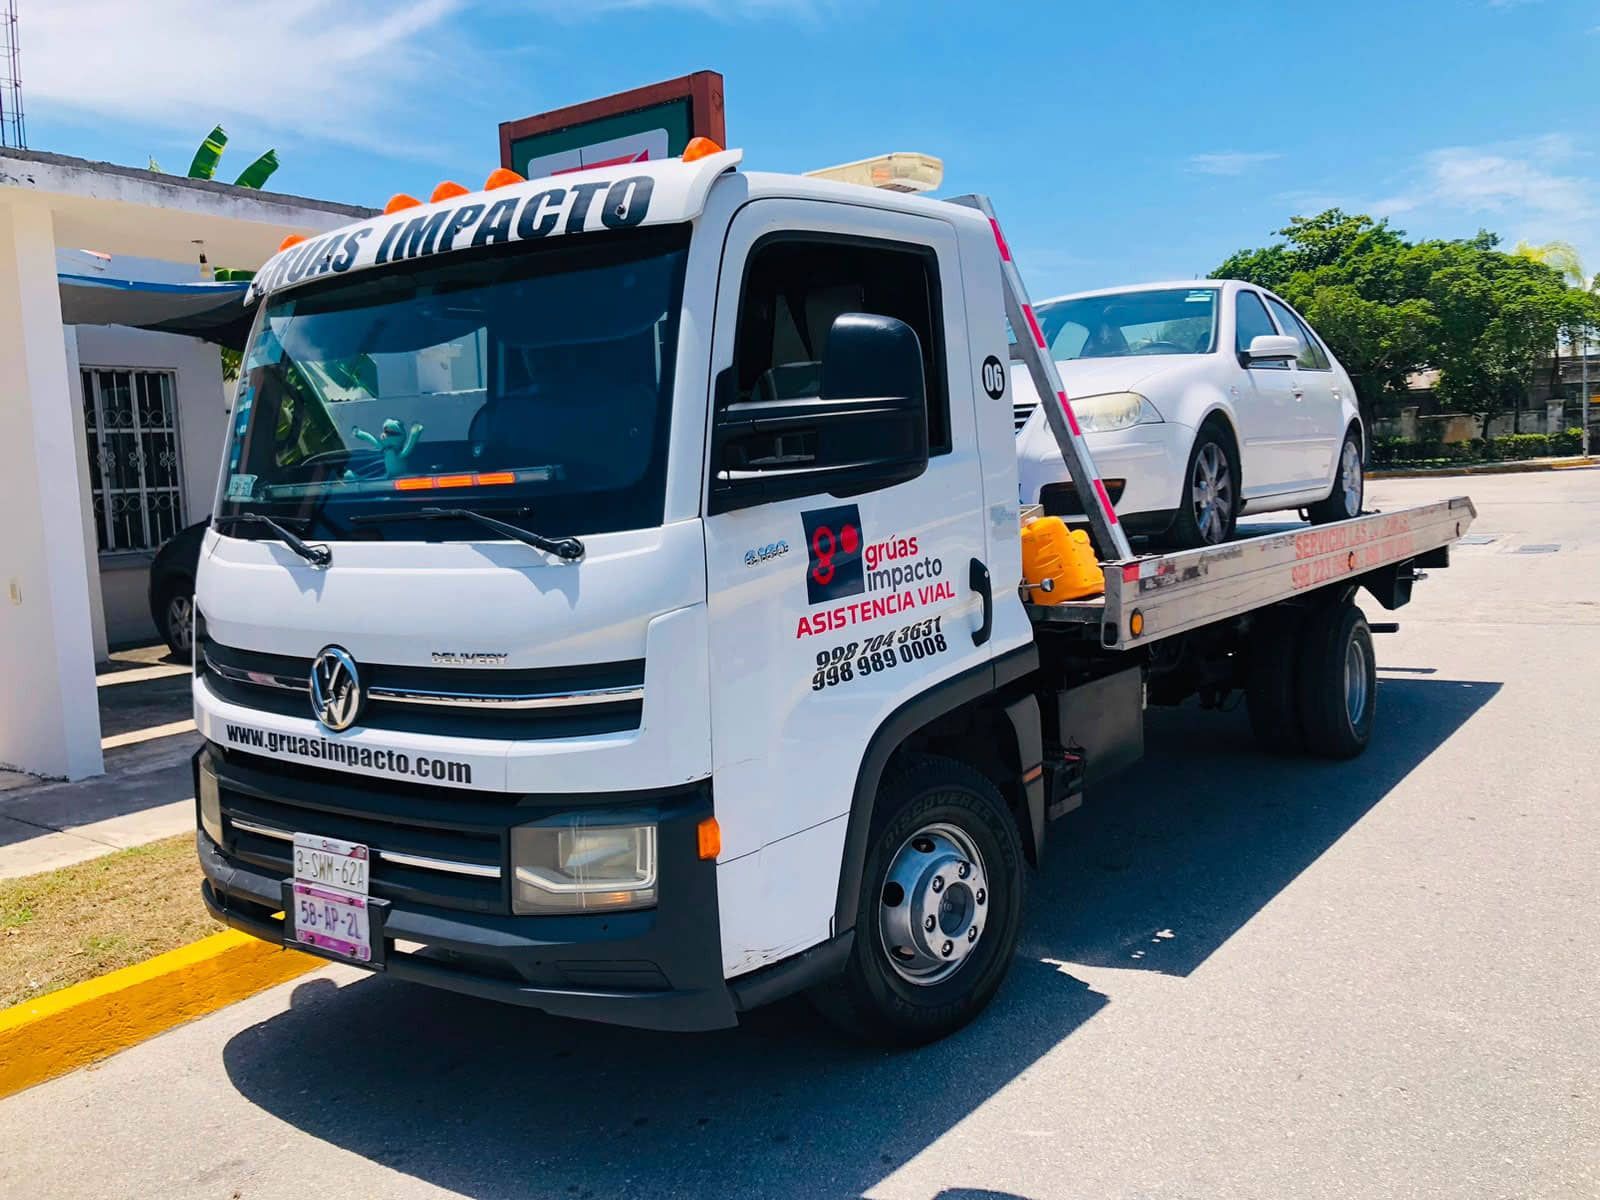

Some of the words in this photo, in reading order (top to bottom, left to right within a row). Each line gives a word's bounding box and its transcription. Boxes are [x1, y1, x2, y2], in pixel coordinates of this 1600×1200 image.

[375, 176, 655, 264] IMPACTO
[984, 363, 1003, 392] 06
[865, 535, 919, 571] grúas
[867, 556, 943, 592] impacto
[796, 591, 915, 639] ASISTENCIA
[919, 581, 956, 605] VIAL
[431, 652, 509, 666] DELIVERY
[812, 661, 854, 691] 998
[857, 649, 898, 677] 989
[901, 633, 948, 664] 0008
[816, 642, 859, 671] 998
[863, 627, 895, 653] 704
[898, 616, 943, 643] 3631
[226, 724, 472, 784] www.gruasimpacto.com
[301, 900, 362, 940] 58-AP-2L
